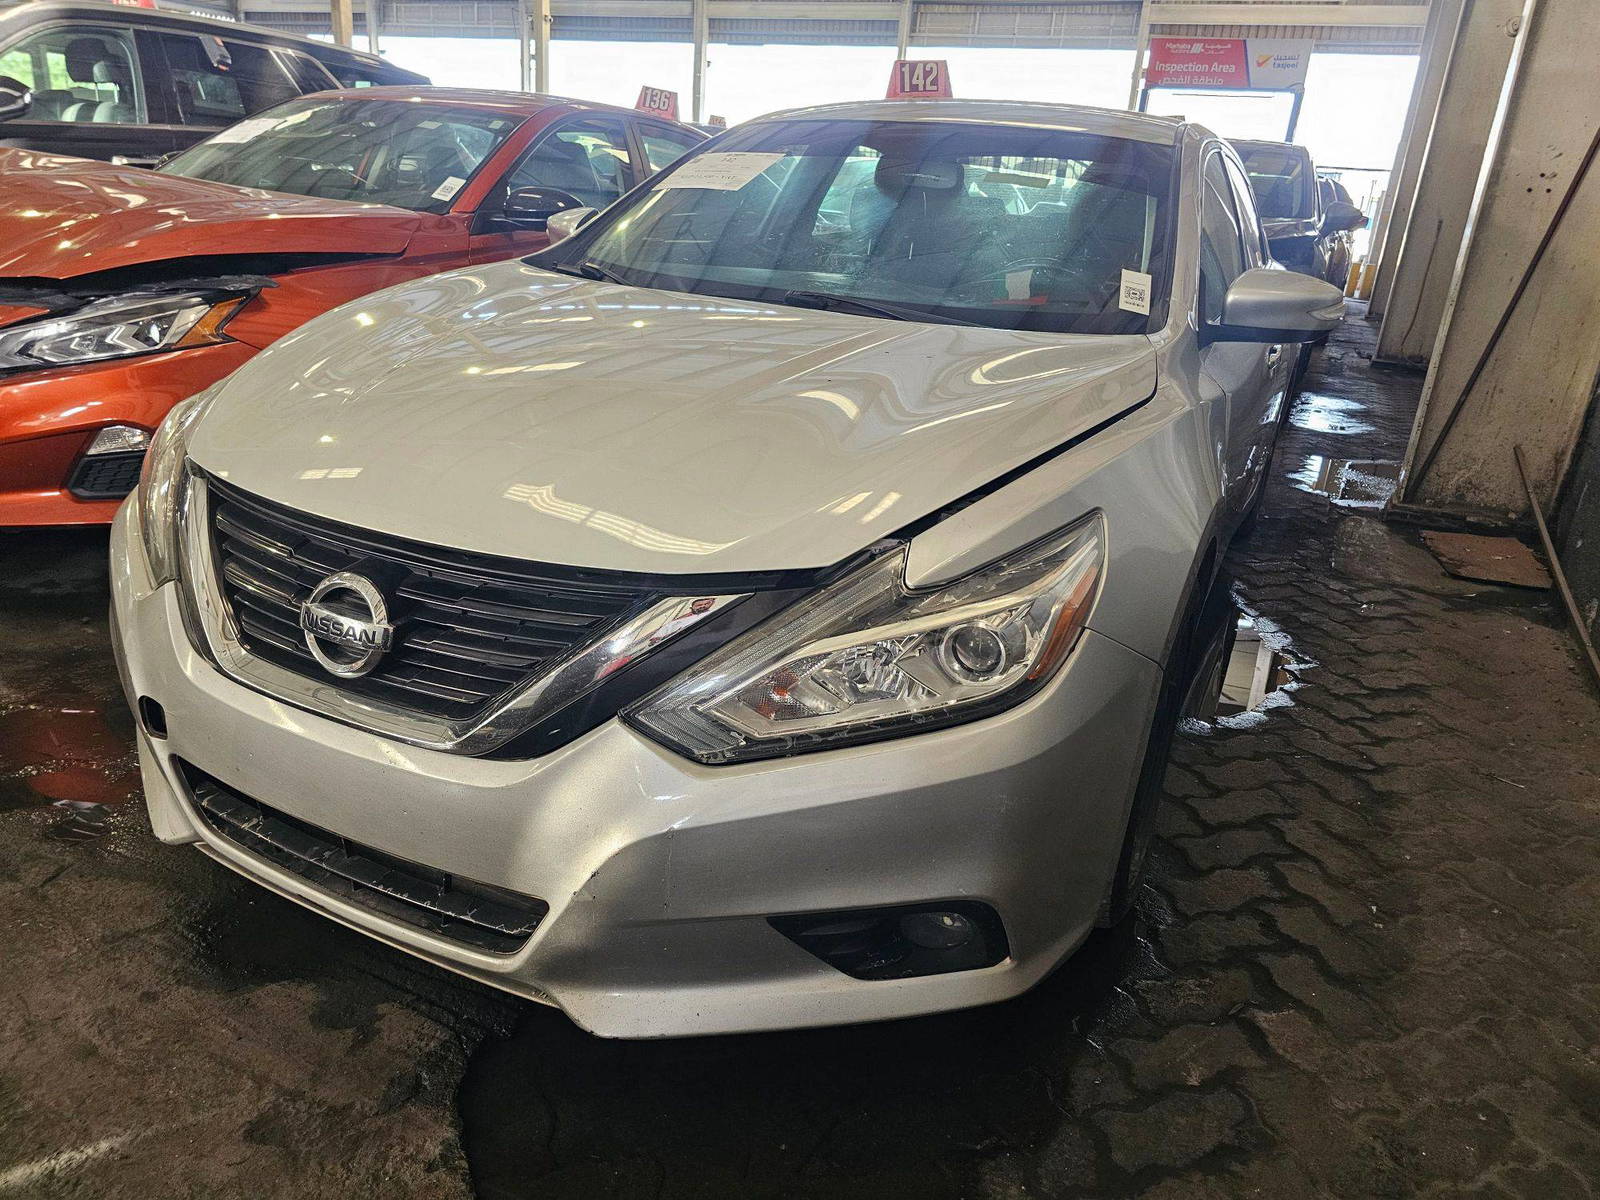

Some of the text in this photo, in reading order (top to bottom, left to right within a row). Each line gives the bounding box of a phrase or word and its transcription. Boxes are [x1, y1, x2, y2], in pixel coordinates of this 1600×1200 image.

[901, 63, 938, 92] 142
[1155, 61, 1236, 74] Inspection Area
[645, 89, 671, 111] 136
[303, 608, 377, 647] NISSAN
